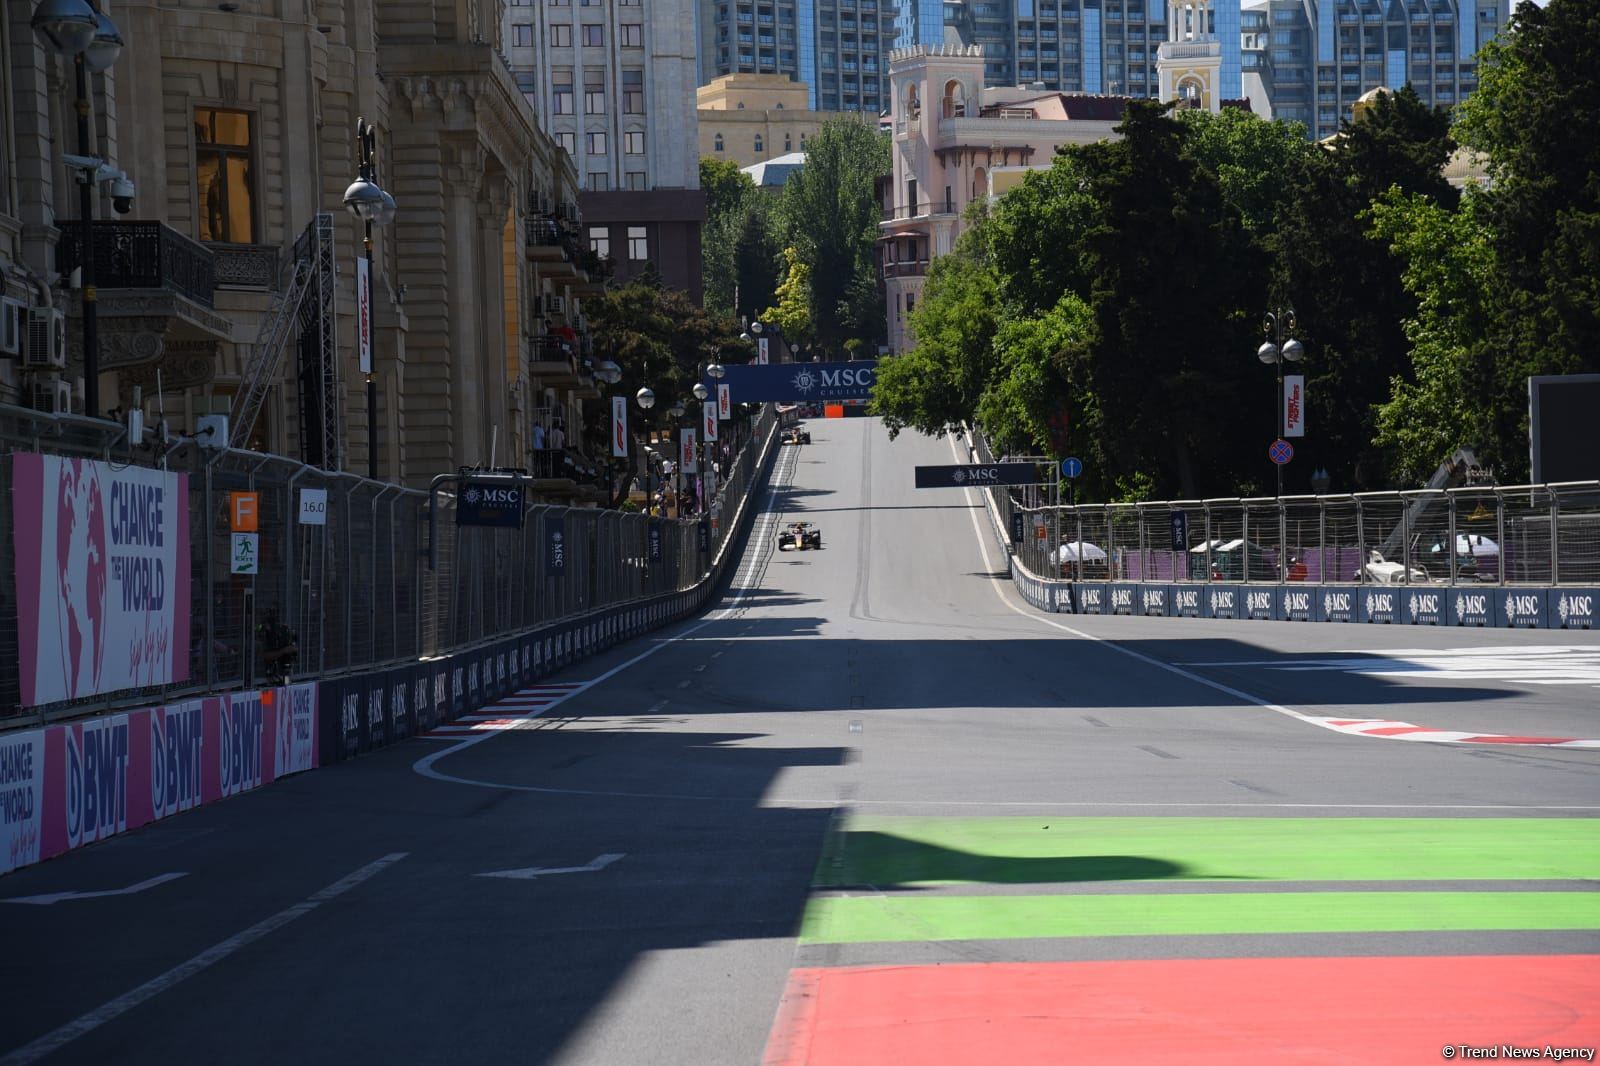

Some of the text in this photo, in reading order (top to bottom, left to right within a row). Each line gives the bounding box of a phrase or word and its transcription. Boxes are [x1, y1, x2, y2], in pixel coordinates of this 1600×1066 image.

[820, 368, 872, 387] MSC
[968, 468, 999, 480] MSC
[484, 488, 519, 503] MSC
[110, 480, 163, 547] CHANGE
[236, 496, 256, 528] F
[303, 502, 325, 513] 16.0
[554, 543, 564, 568] MSC
[111, 556, 121, 580] THE
[121, 557, 165, 612] WORLD
[1087, 590, 1100, 604] MSC
[1118, 590, 1131, 605] MSC
[1150, 591, 1163, 606] MSC
[1183, 591, 1197, 607] MSC
[1218, 592, 1233, 608] MSC
[1254, 593, 1270, 609] MSC
[1292, 593, 1309, 610] MSC
[1332, 594, 1350, 610] MSC
[1375, 594, 1393, 611] MSC
[1418, 595, 1439, 613] MSC
[1465, 595, 1486, 614] MSC
[1515, 595, 1538, 615] MSC
[1569, 596, 1592, 616] MSC
[232, 699, 262, 786] BWT
[0, 743, 32, 784] HANGE
[166, 709, 202, 806] BWT
[84, 724, 128, 832] BWT
[3, 786, 33, 825] WORLD
